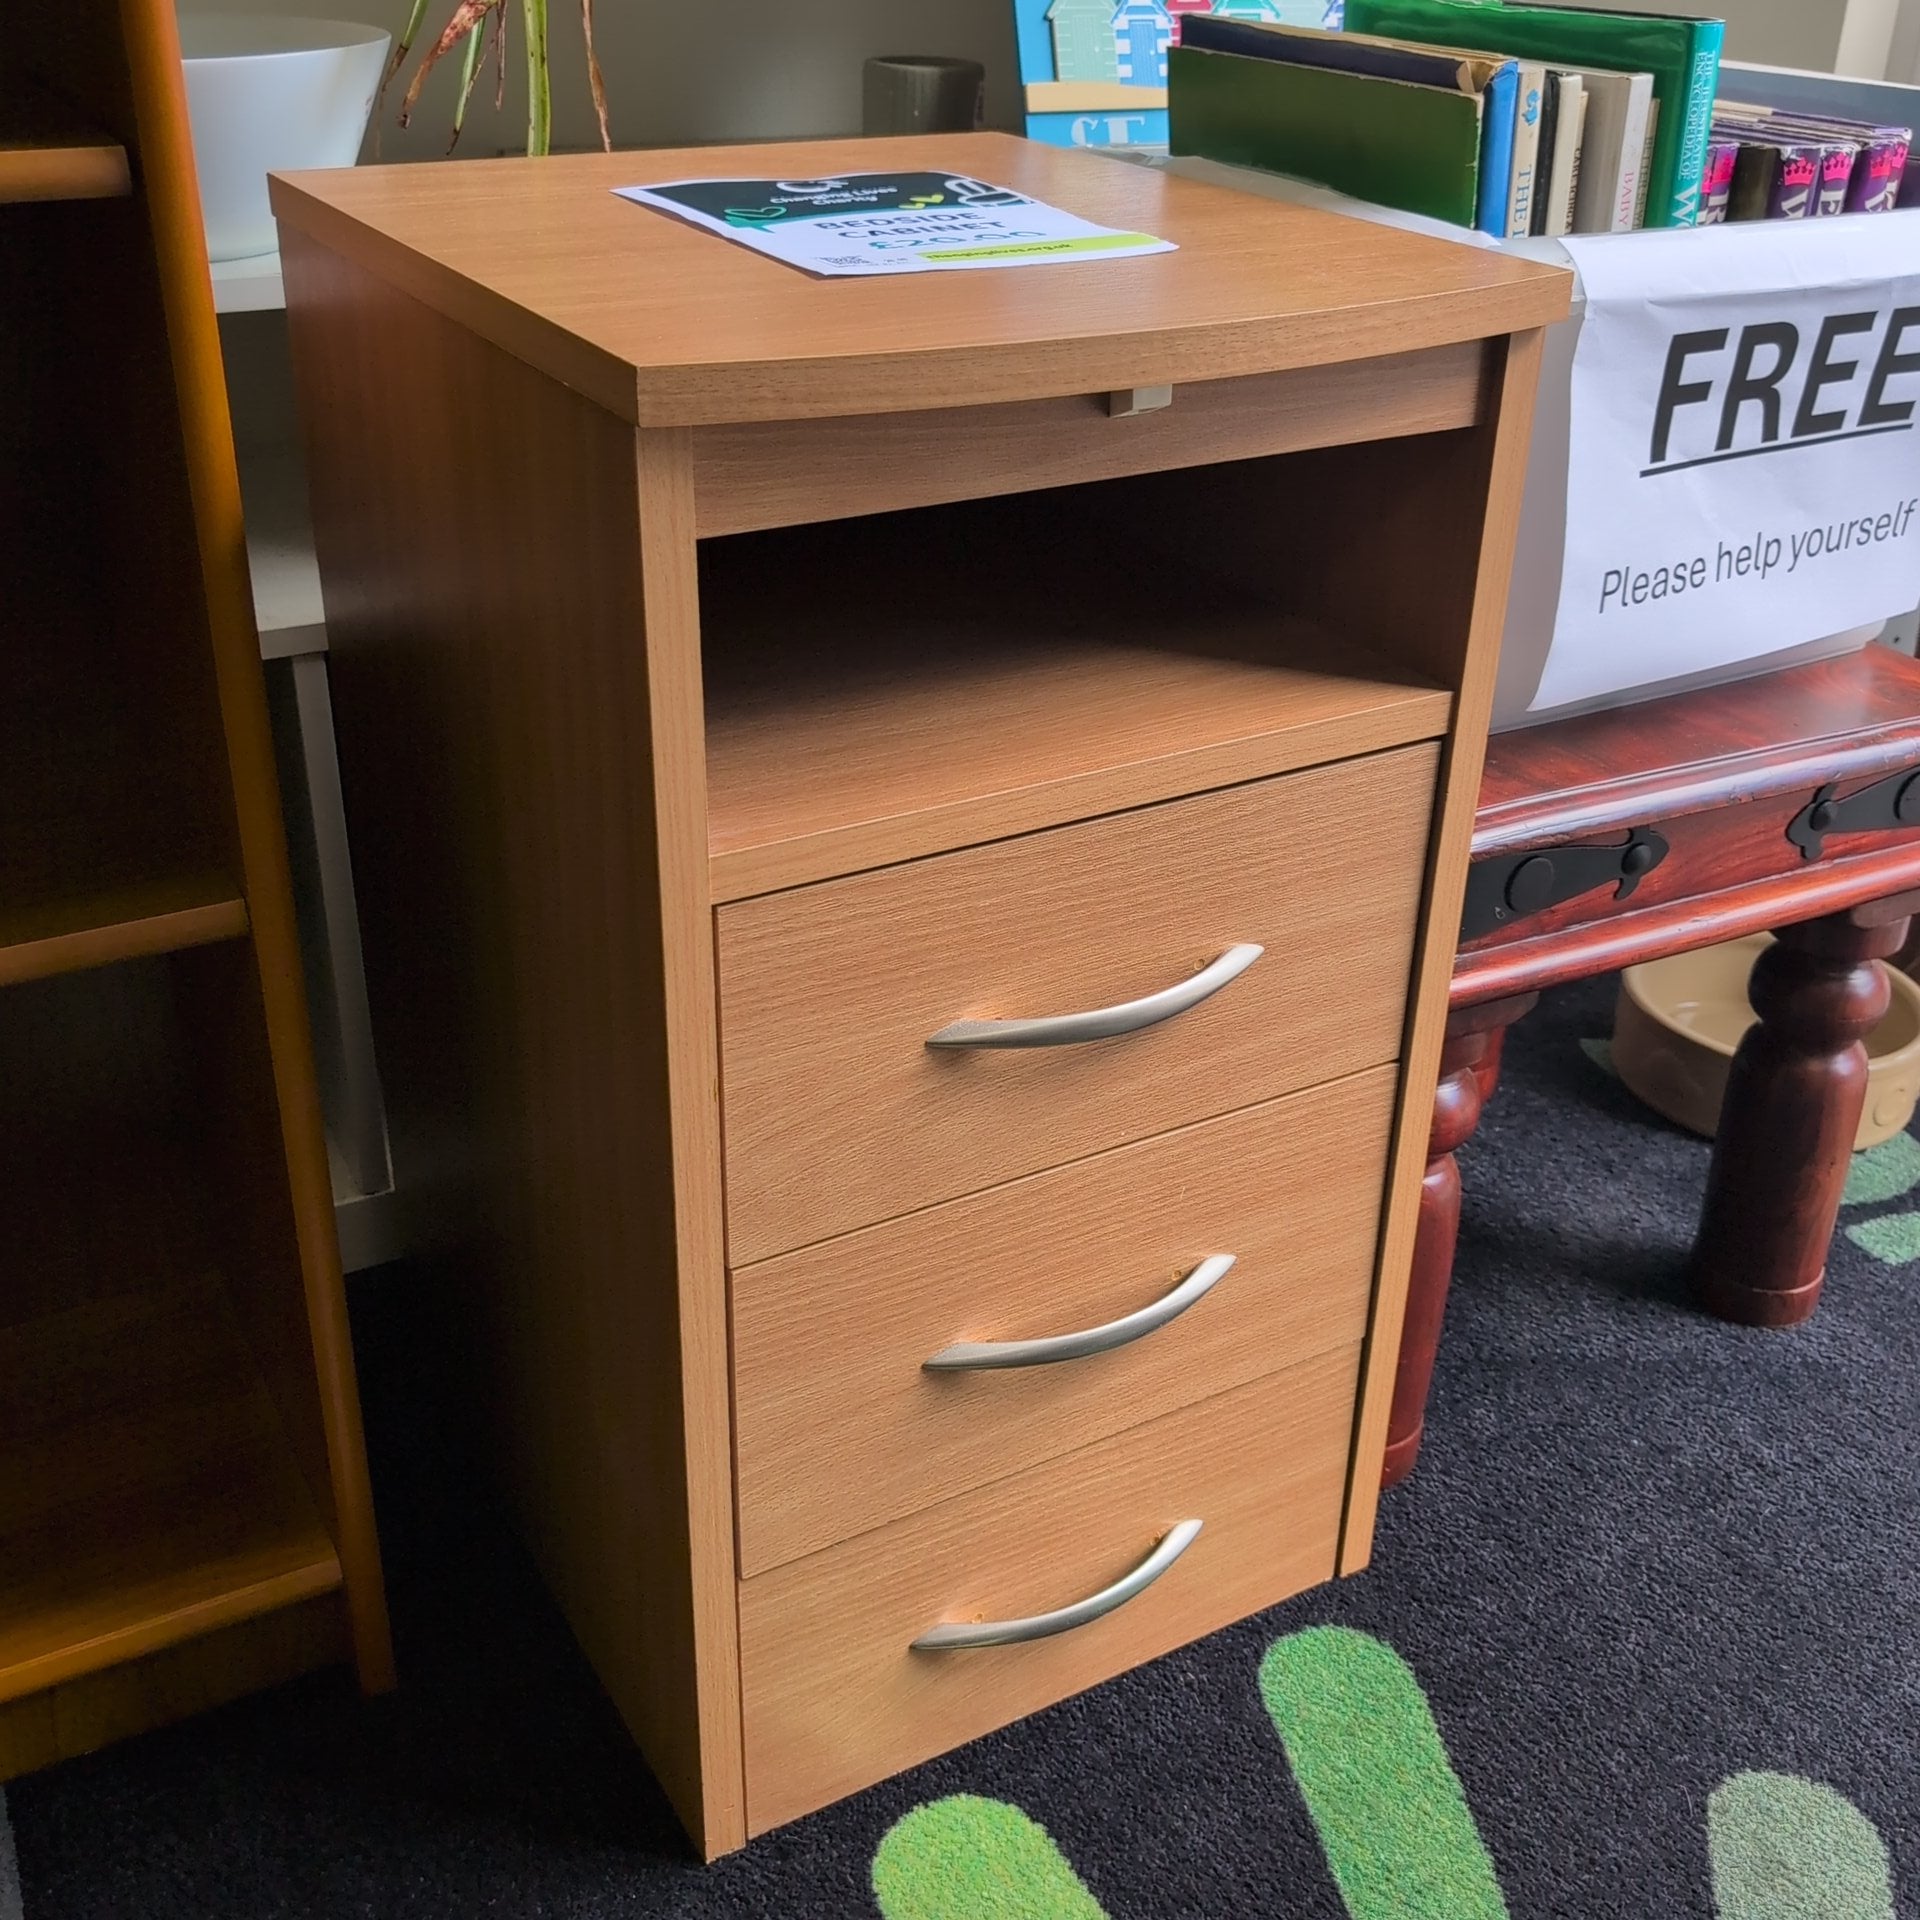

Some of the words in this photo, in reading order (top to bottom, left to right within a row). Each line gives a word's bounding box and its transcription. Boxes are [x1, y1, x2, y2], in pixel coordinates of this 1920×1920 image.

[1683, 51, 1706, 160] ENCYCLOPEDIA
[769, 189, 854, 204] Changing
[852, 186, 898, 197] Lives
[812, 195, 878, 206] Charity
[1513, 164, 1532, 223] THE
[1619, 172, 1634, 225] BABY
[813, 212, 986, 230] BEDSIDE
[837, 221, 1007, 239] CABINET
[868, 231, 1048, 250] £20.00
[1649, 305, 1920, 464] FREE
[1598, 556, 1707, 615] Please
[1715, 531, 1782, 580] help
[1786, 498, 1919, 573] yourself
